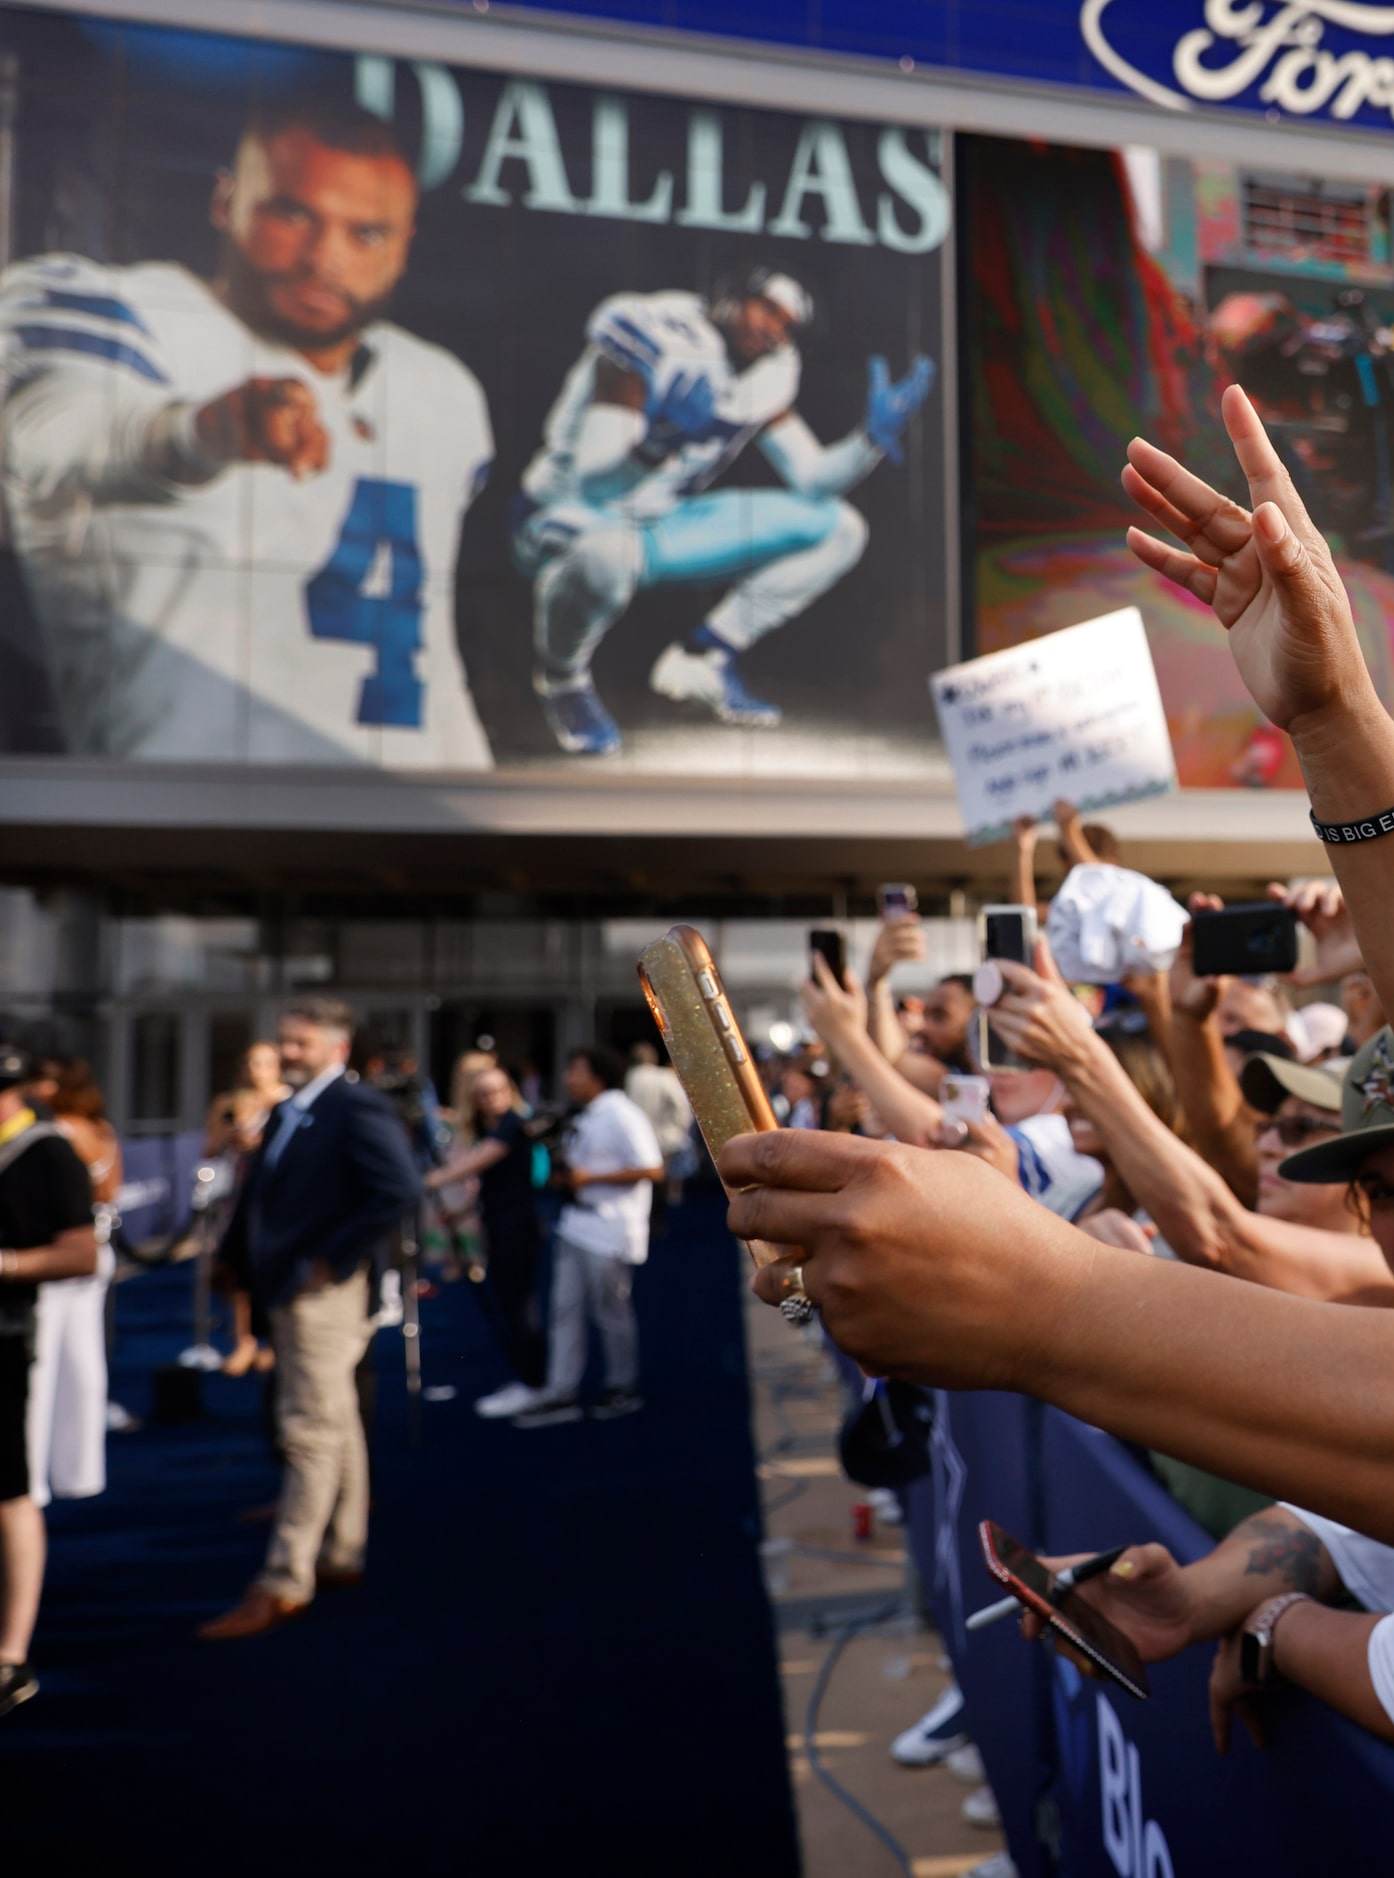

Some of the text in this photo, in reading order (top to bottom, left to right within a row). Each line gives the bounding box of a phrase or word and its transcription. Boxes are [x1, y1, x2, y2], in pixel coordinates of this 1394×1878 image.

[354, 52, 952, 254] DALLAS
[304, 477, 427, 729] 4
[1325, 828, 1341, 842] IS
[1343, 823, 1377, 842] BIG
